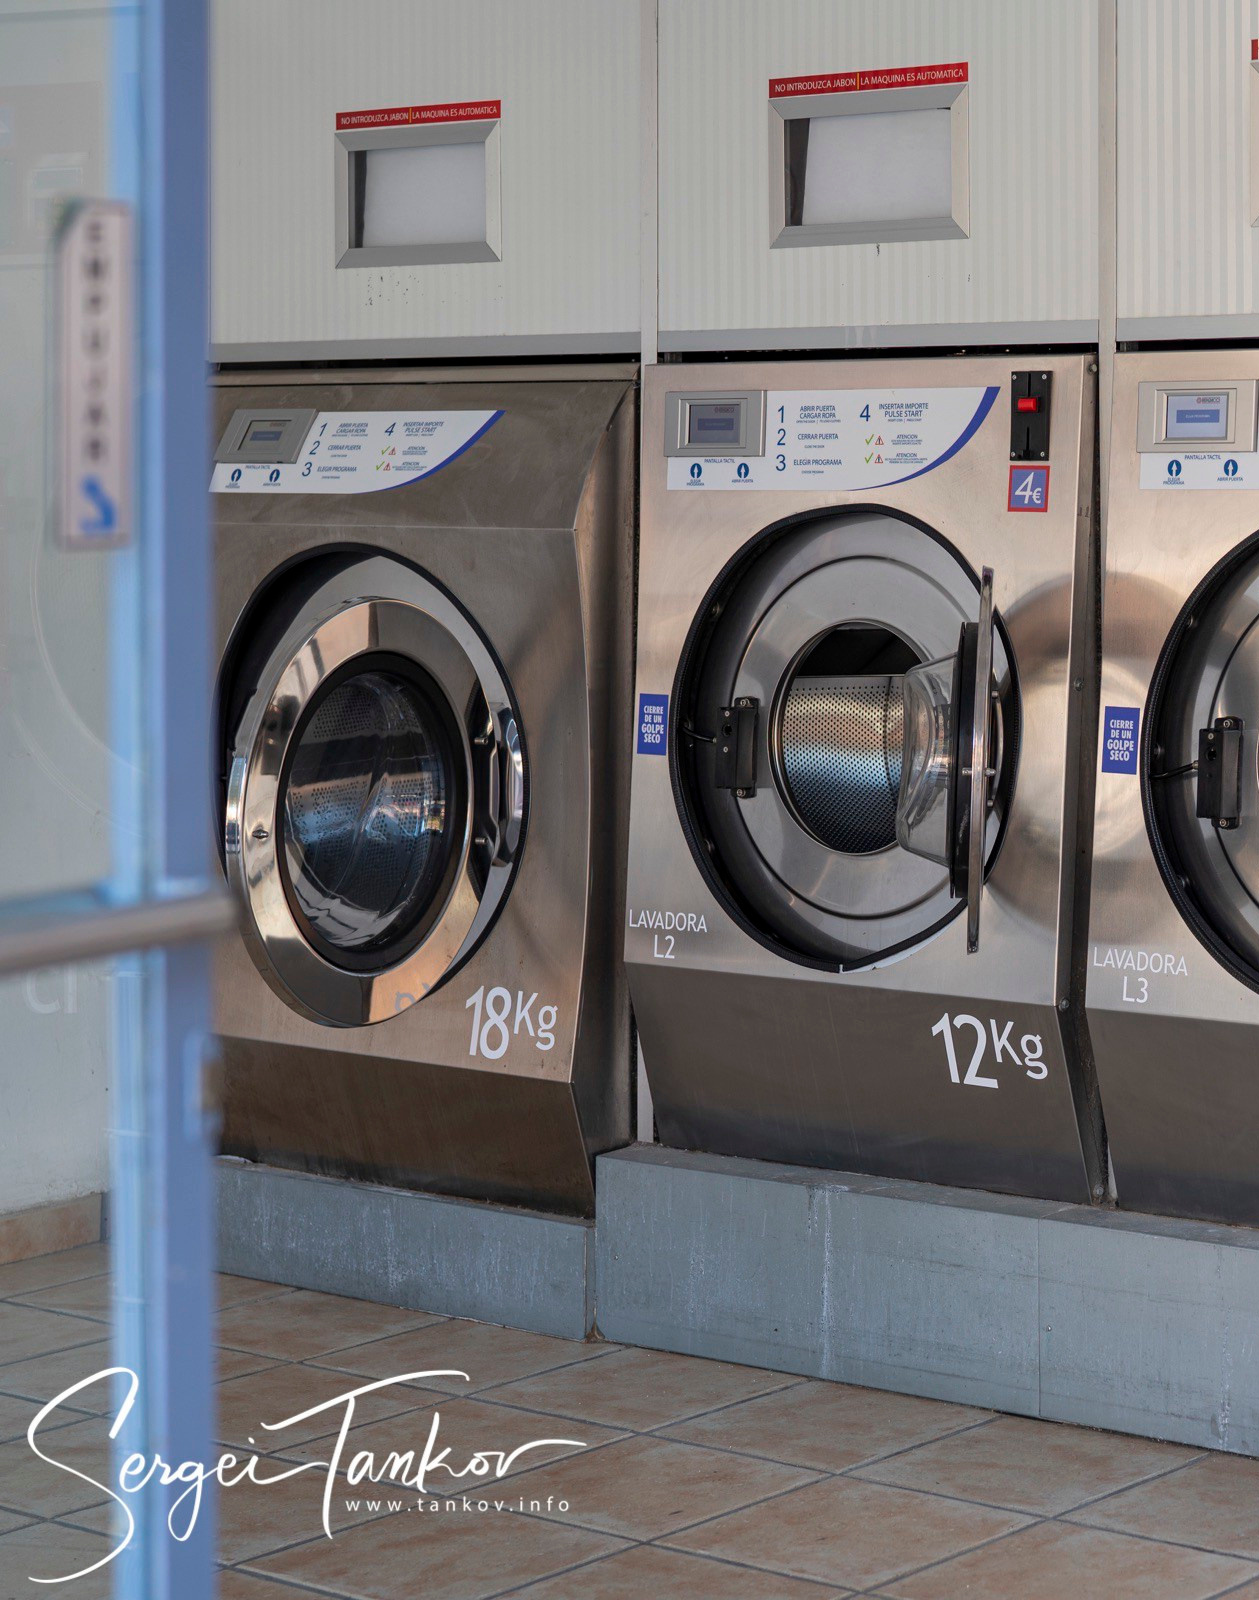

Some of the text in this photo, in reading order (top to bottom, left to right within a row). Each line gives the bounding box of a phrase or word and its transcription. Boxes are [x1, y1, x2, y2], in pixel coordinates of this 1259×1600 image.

[775, 68, 964, 92] NO INTRODUZCA JABON LA MAQUINA ES AUTOMATICA
[341, 106, 497, 125] NO INTRODUZCA JABON LA MAQUINA ES AUTOMATICA
[859, 404, 871, 422] 4
[884, 410, 923, 418] PULSE START
[905, 402, 929, 410] IMPORTE
[777, 405, 785, 424] 1
[319, 422, 328, 437] 1
[384, 422, 397, 437] 4
[776, 428, 786, 446] 2
[309, 440, 321, 455] 2
[301, 461, 313, 477] 3
[775, 454, 786, 472] 3
[1014, 471, 1042, 504] 4€
[643, 705, 664, 715] CIERRE
[644, 714, 662, 724] DE UN
[1109, 719, 1134, 730] CIERRE
[641, 723, 665, 734] GOLPE
[1110, 729, 1132, 739] DE UN
[643, 733, 661, 744] SECO
[1107, 739, 1135, 752] GOLPE
[1109, 750, 1130, 762] SECO
[629, 908, 708, 933] LAVADORA
[653, 934, 675, 959] L2
[1093, 946, 1188, 976] LAVADORA
[1122, 976, 1148, 1004] L3
[465, 985, 559, 1060] 18Kg
[931, 1012, 1048, 1089] 12Kg
